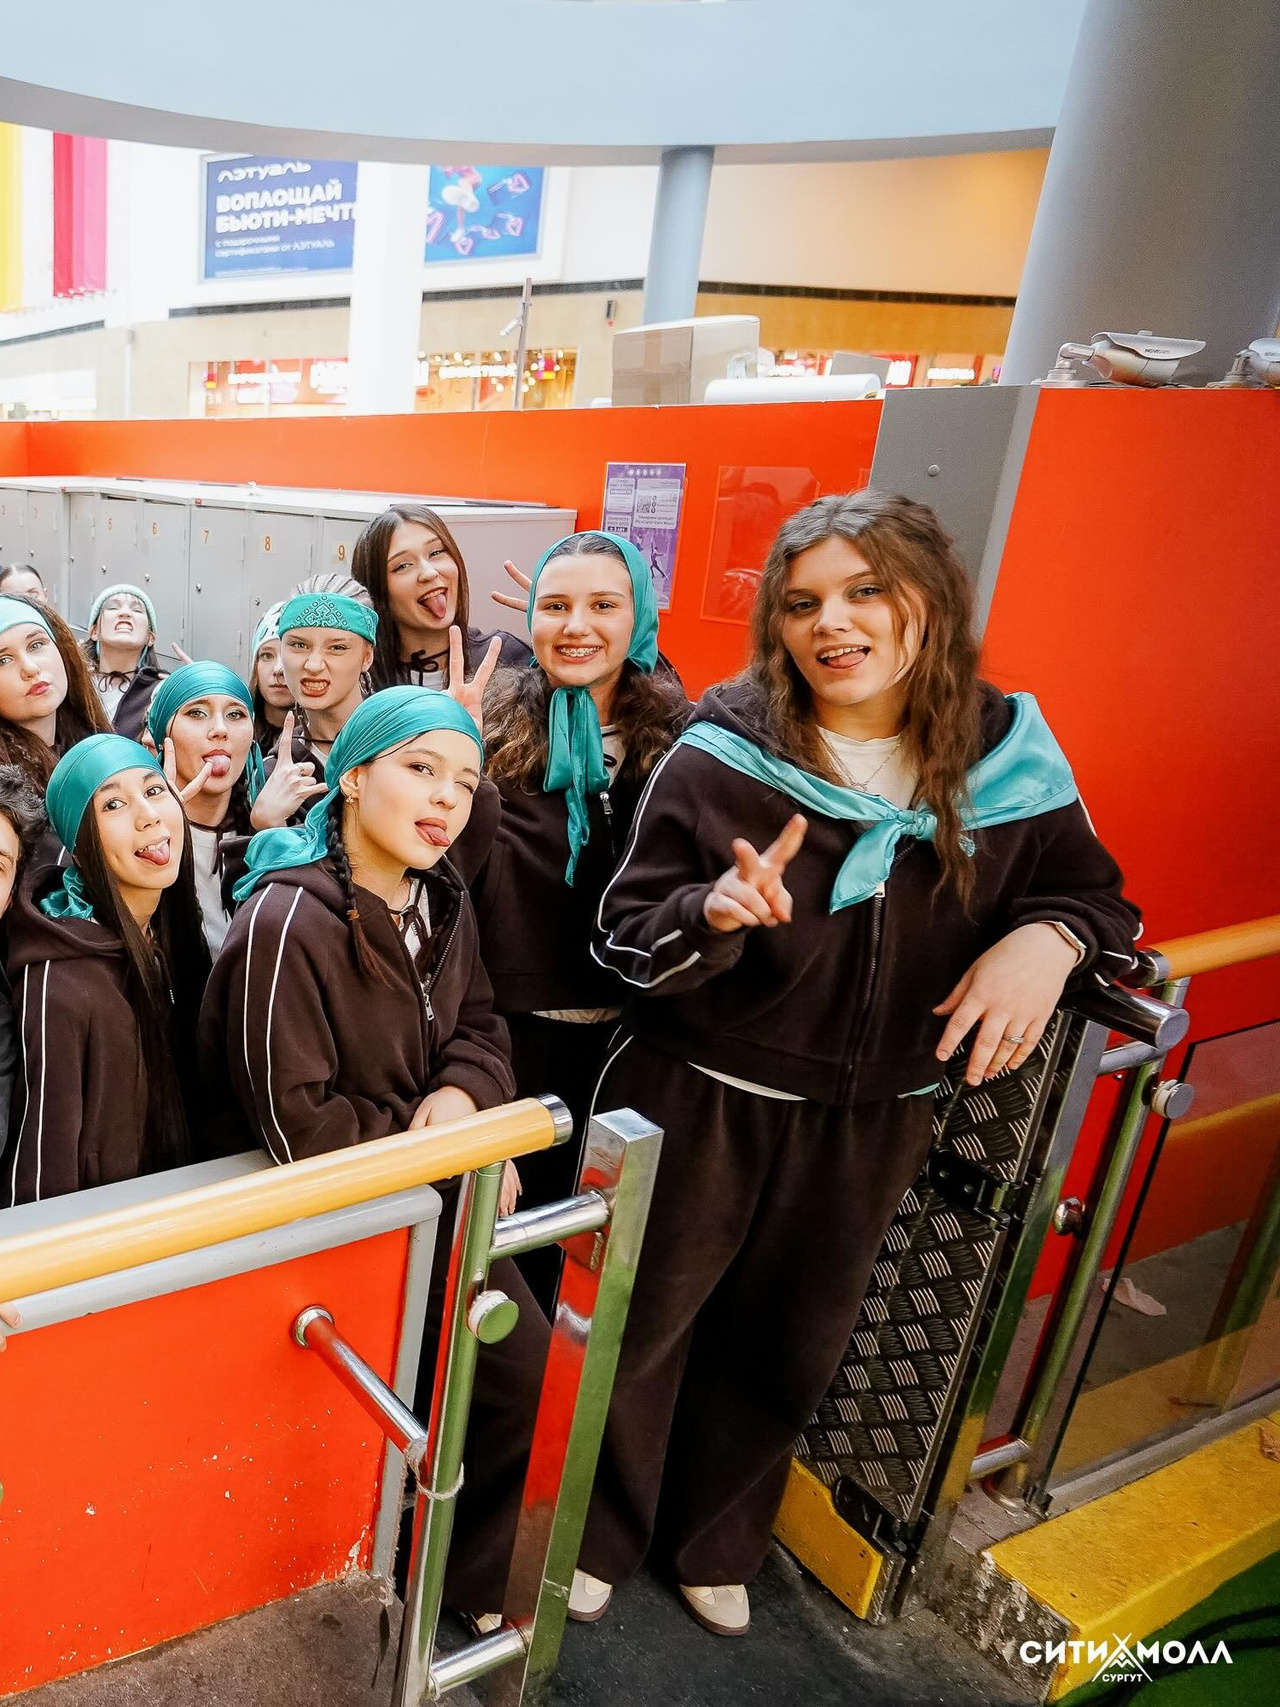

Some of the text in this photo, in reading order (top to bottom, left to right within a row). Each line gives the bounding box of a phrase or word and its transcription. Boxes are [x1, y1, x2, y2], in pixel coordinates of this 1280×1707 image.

[216, 177, 343, 213] ВОПЛОЩАЙ
[107, 518, 113, 530] 5
[152, 522, 158, 535] 6
[204, 530, 210, 544] 7
[264, 536, 271, 551] 8
[338, 544, 346, 561] 9
